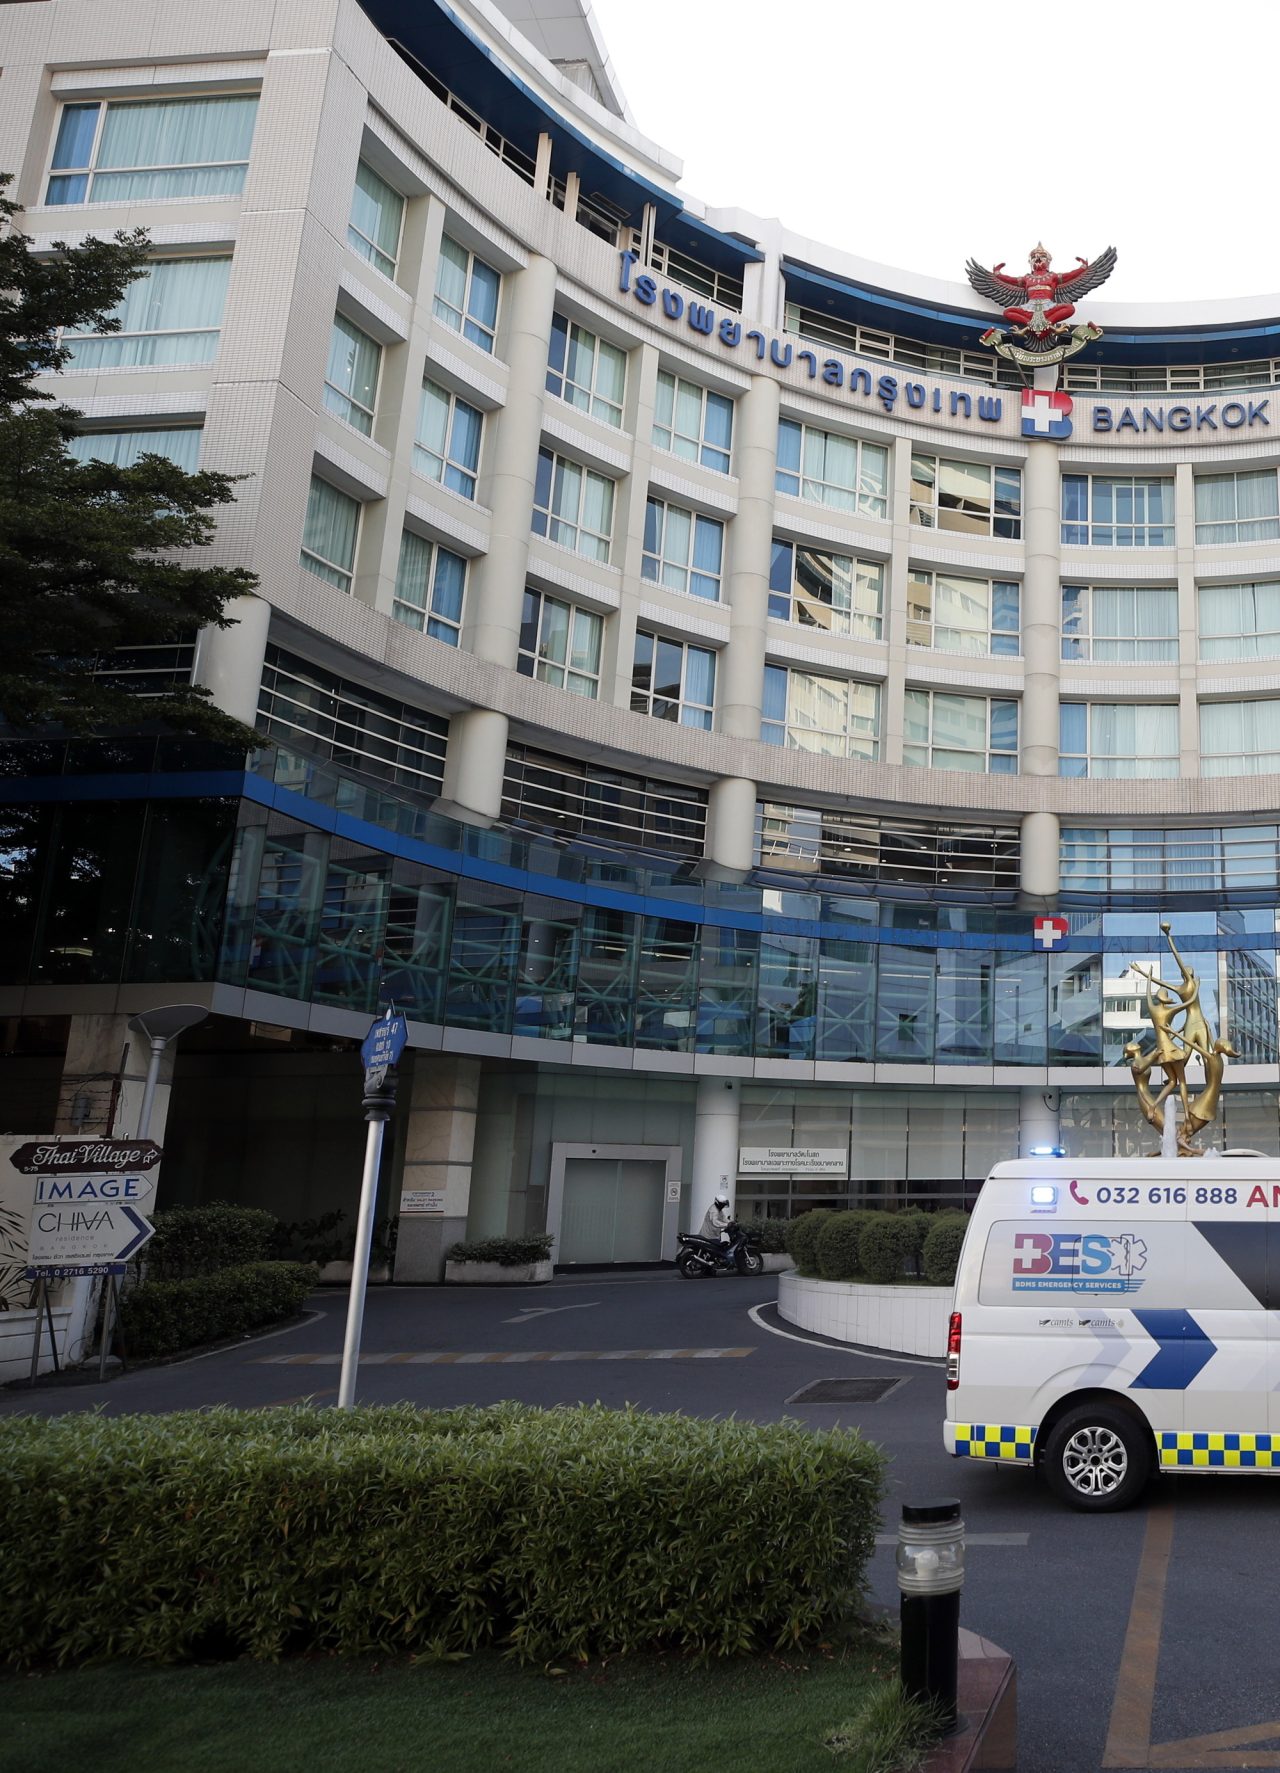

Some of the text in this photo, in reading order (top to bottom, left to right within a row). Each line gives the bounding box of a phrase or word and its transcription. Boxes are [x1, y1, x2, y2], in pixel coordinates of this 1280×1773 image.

[620, 250, 1002, 422] โรงพยาบาลกรุงเทพ
[1092, 400, 1270, 432] BANGKOK
[32, 1144, 141, 1168] Thai Village
[38, 1178, 140, 1200] IMAGE
[1096, 1187, 1140, 1204] 032
[1148, 1187, 1187, 1204] 616
[1195, 1187, 1238, 1204] 888
[38, 1210, 114, 1233] CHIVA
[1013, 1233, 1112, 1275] BES
[63, 1268, 84, 1276] 2716
[87, 1267, 109, 1275] 5290
[1015, 1280, 1036, 1288] BDMS
[1038, 1281, 1083, 1289] EMERGENCY
